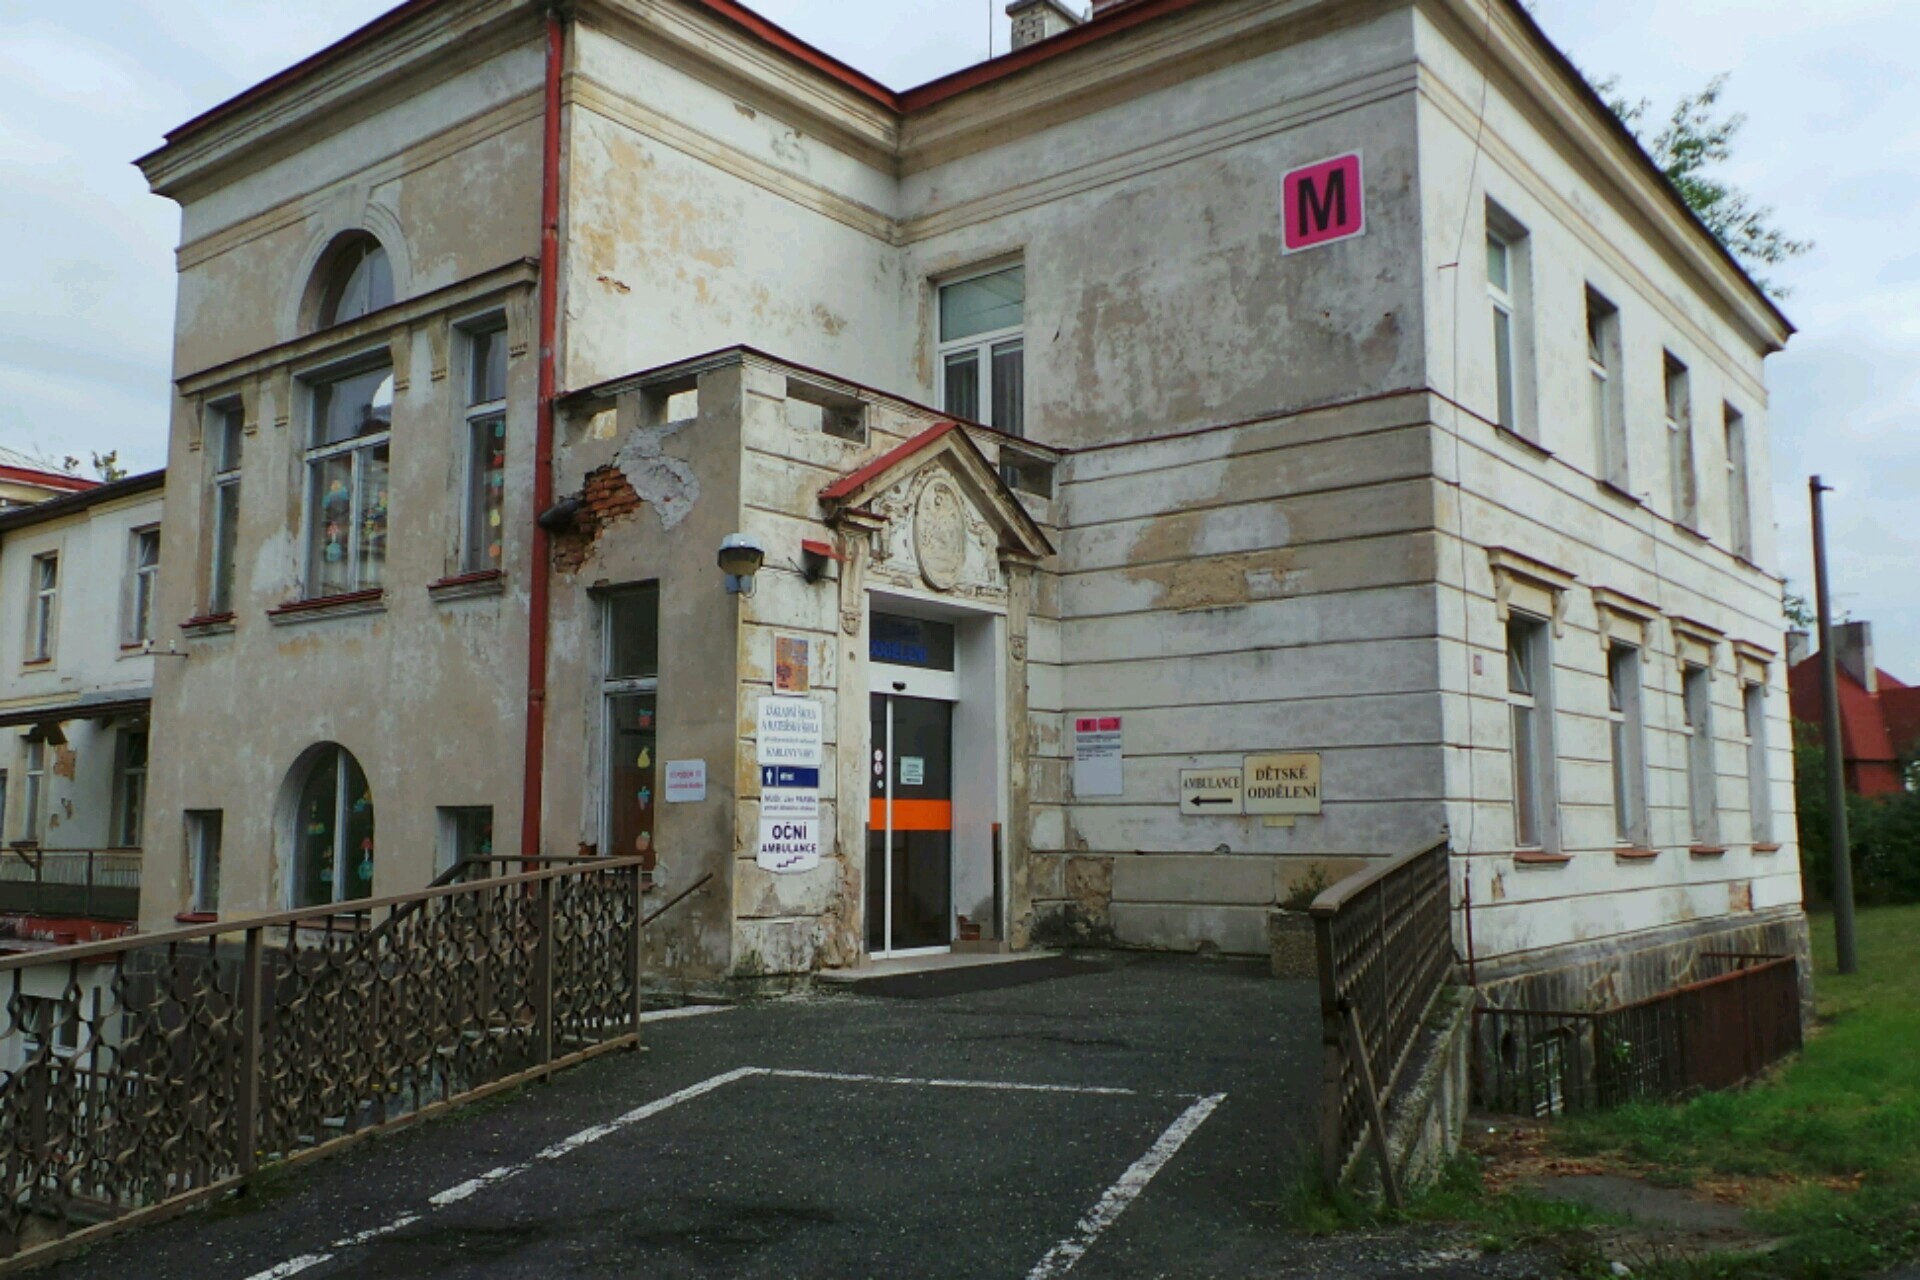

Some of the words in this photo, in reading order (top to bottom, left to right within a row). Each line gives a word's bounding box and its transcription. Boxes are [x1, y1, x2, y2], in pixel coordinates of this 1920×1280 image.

[1298, 167, 1347, 237] M
[1256, 765, 1308, 781] DĚTSKÉ
[1184, 776, 1240, 789] AMBULANCE
[1247, 782, 1317, 799] ODDĚLENÍ
[772, 822, 807, 840] OČNÍ
[761, 843, 816, 855] AMBULANCE
